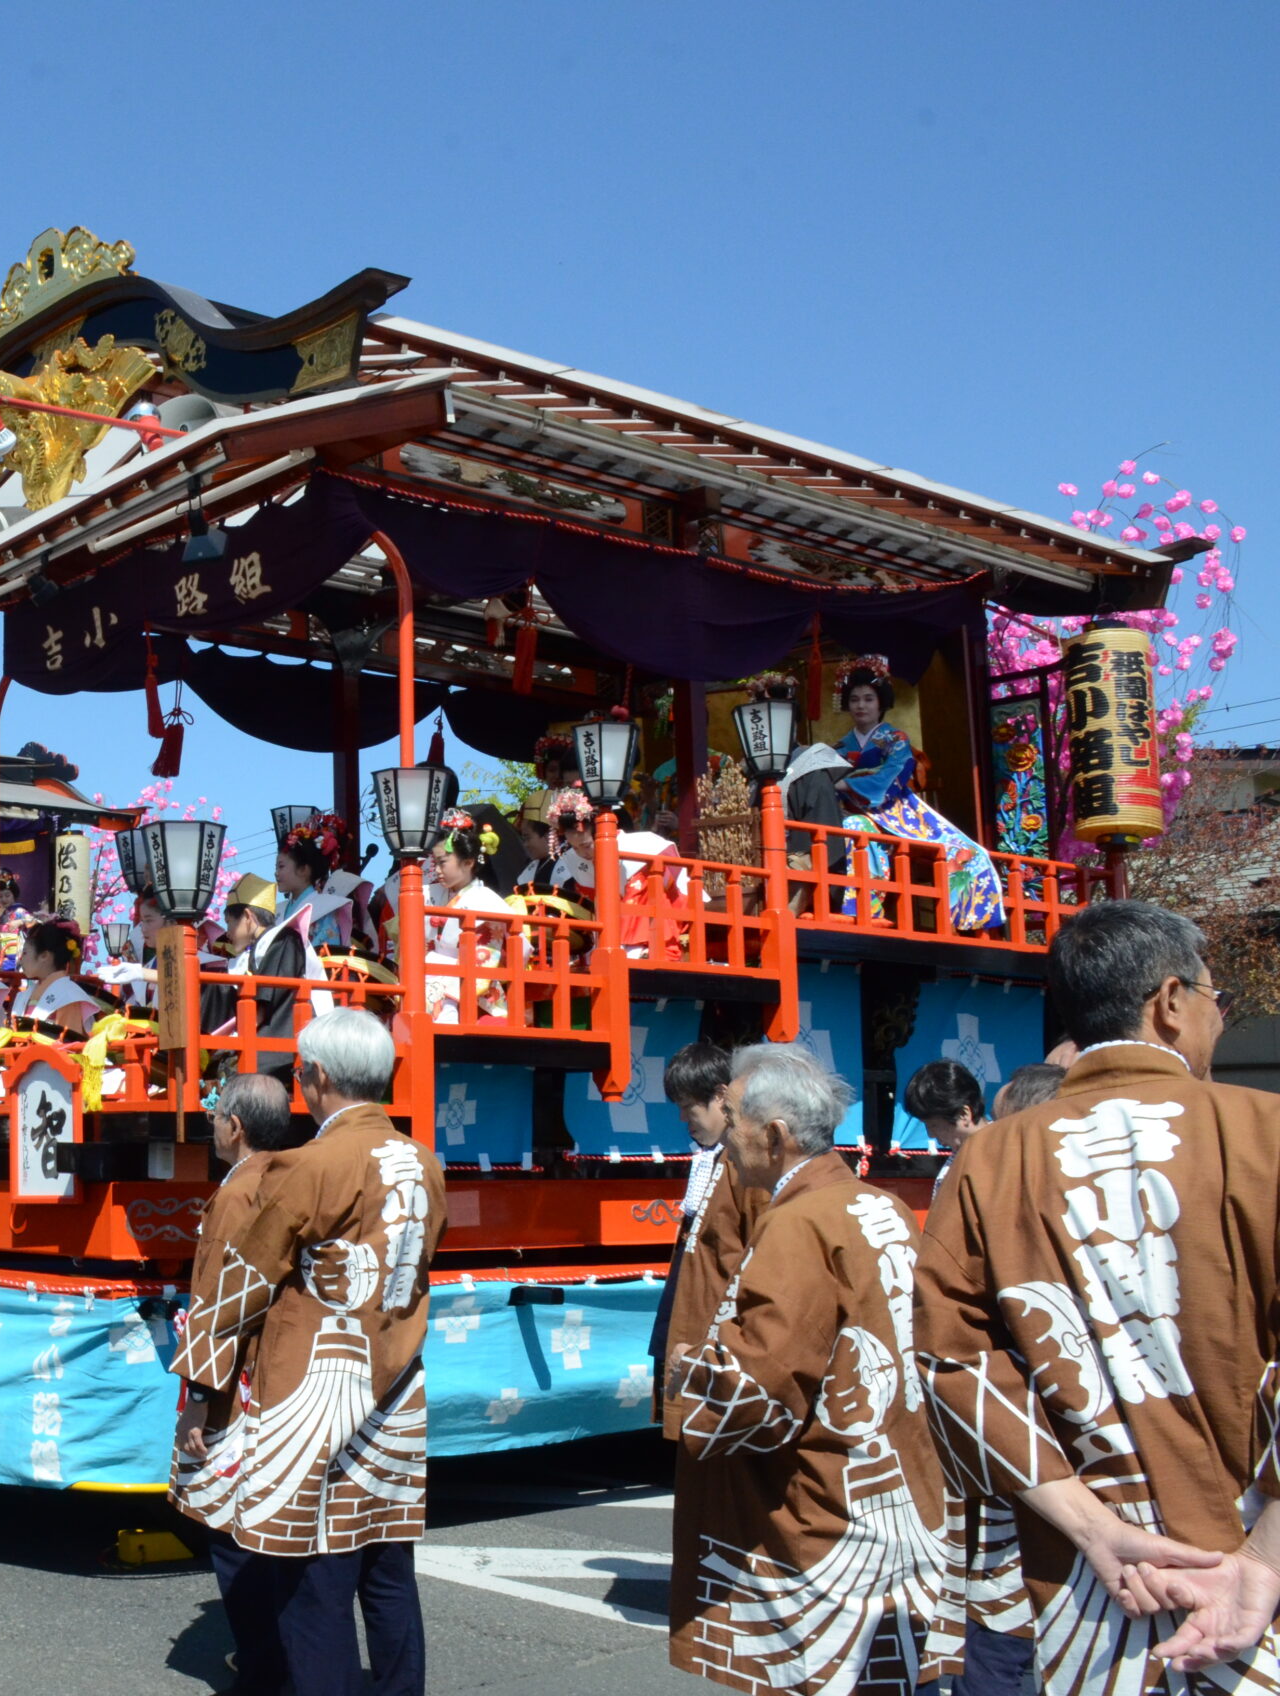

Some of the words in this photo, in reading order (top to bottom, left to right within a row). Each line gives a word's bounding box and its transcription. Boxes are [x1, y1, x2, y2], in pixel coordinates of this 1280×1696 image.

[42, 551, 272, 671] 吉小路組
[582, 731, 599, 778] 吉小路組
[750, 708, 768, 752] 吉小路組
[382, 778, 397, 828] 吉小路組
[150, 832, 166, 887] 吉小路組
[201, 830, 215, 886] 吉小路組
[371, 1139, 429, 1313] 吉小路組
[1049, 1098, 1195, 1405] 吉小路組
